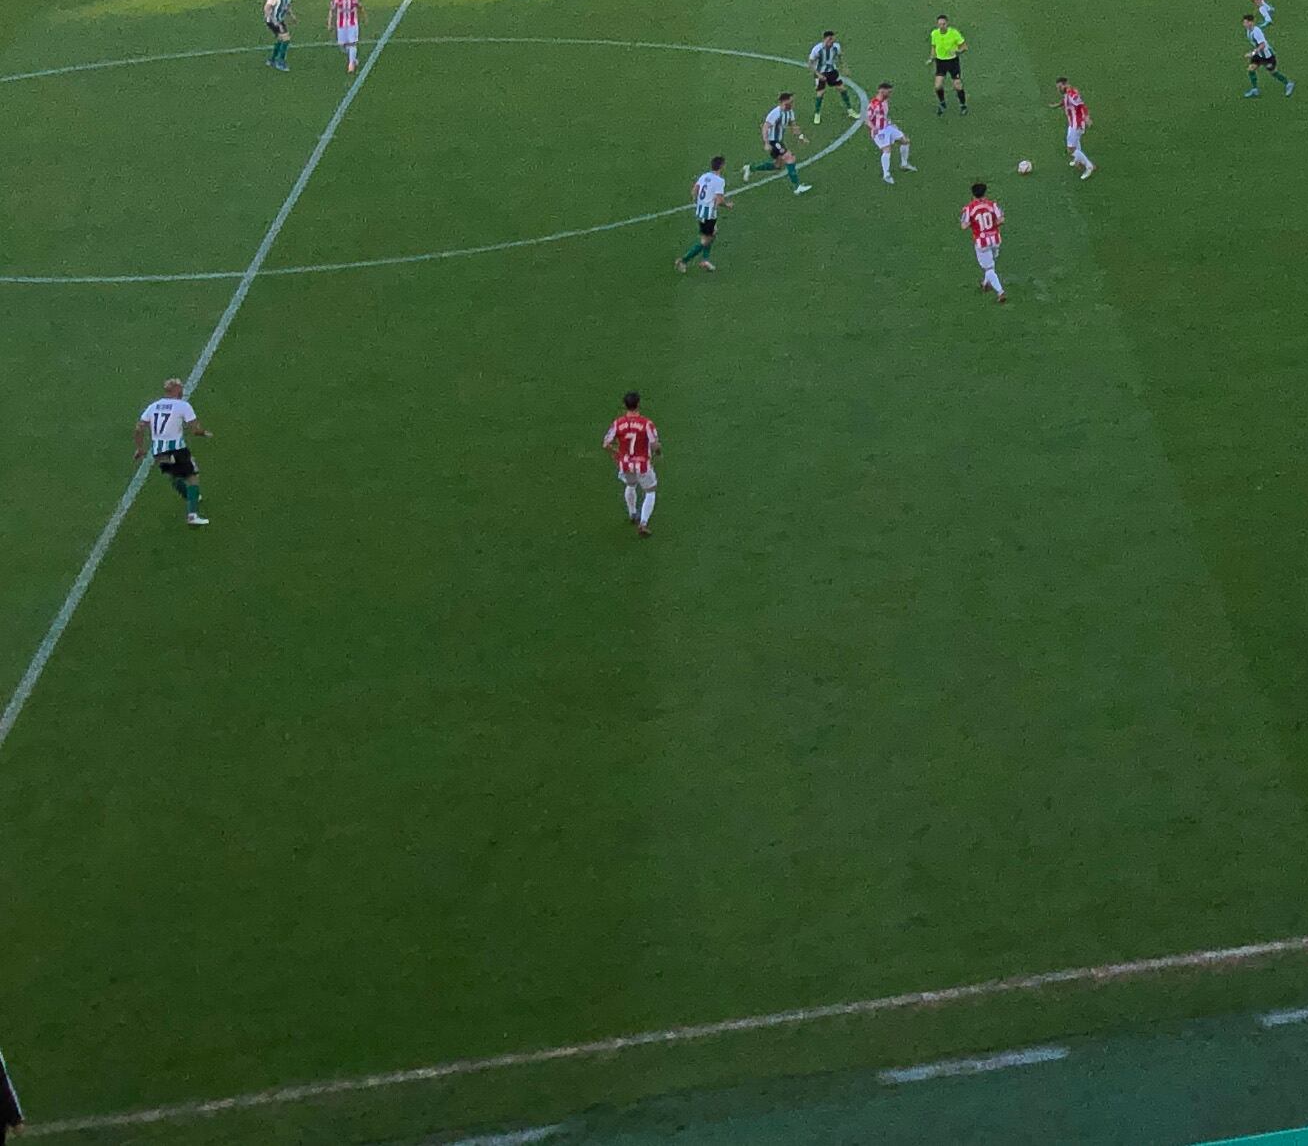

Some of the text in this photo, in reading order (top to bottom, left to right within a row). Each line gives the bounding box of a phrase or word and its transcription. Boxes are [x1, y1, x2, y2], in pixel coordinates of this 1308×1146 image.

[974, 211, 994, 232] 10
[153, 412, 172, 435] 17
[624, 432, 637, 455] 7
